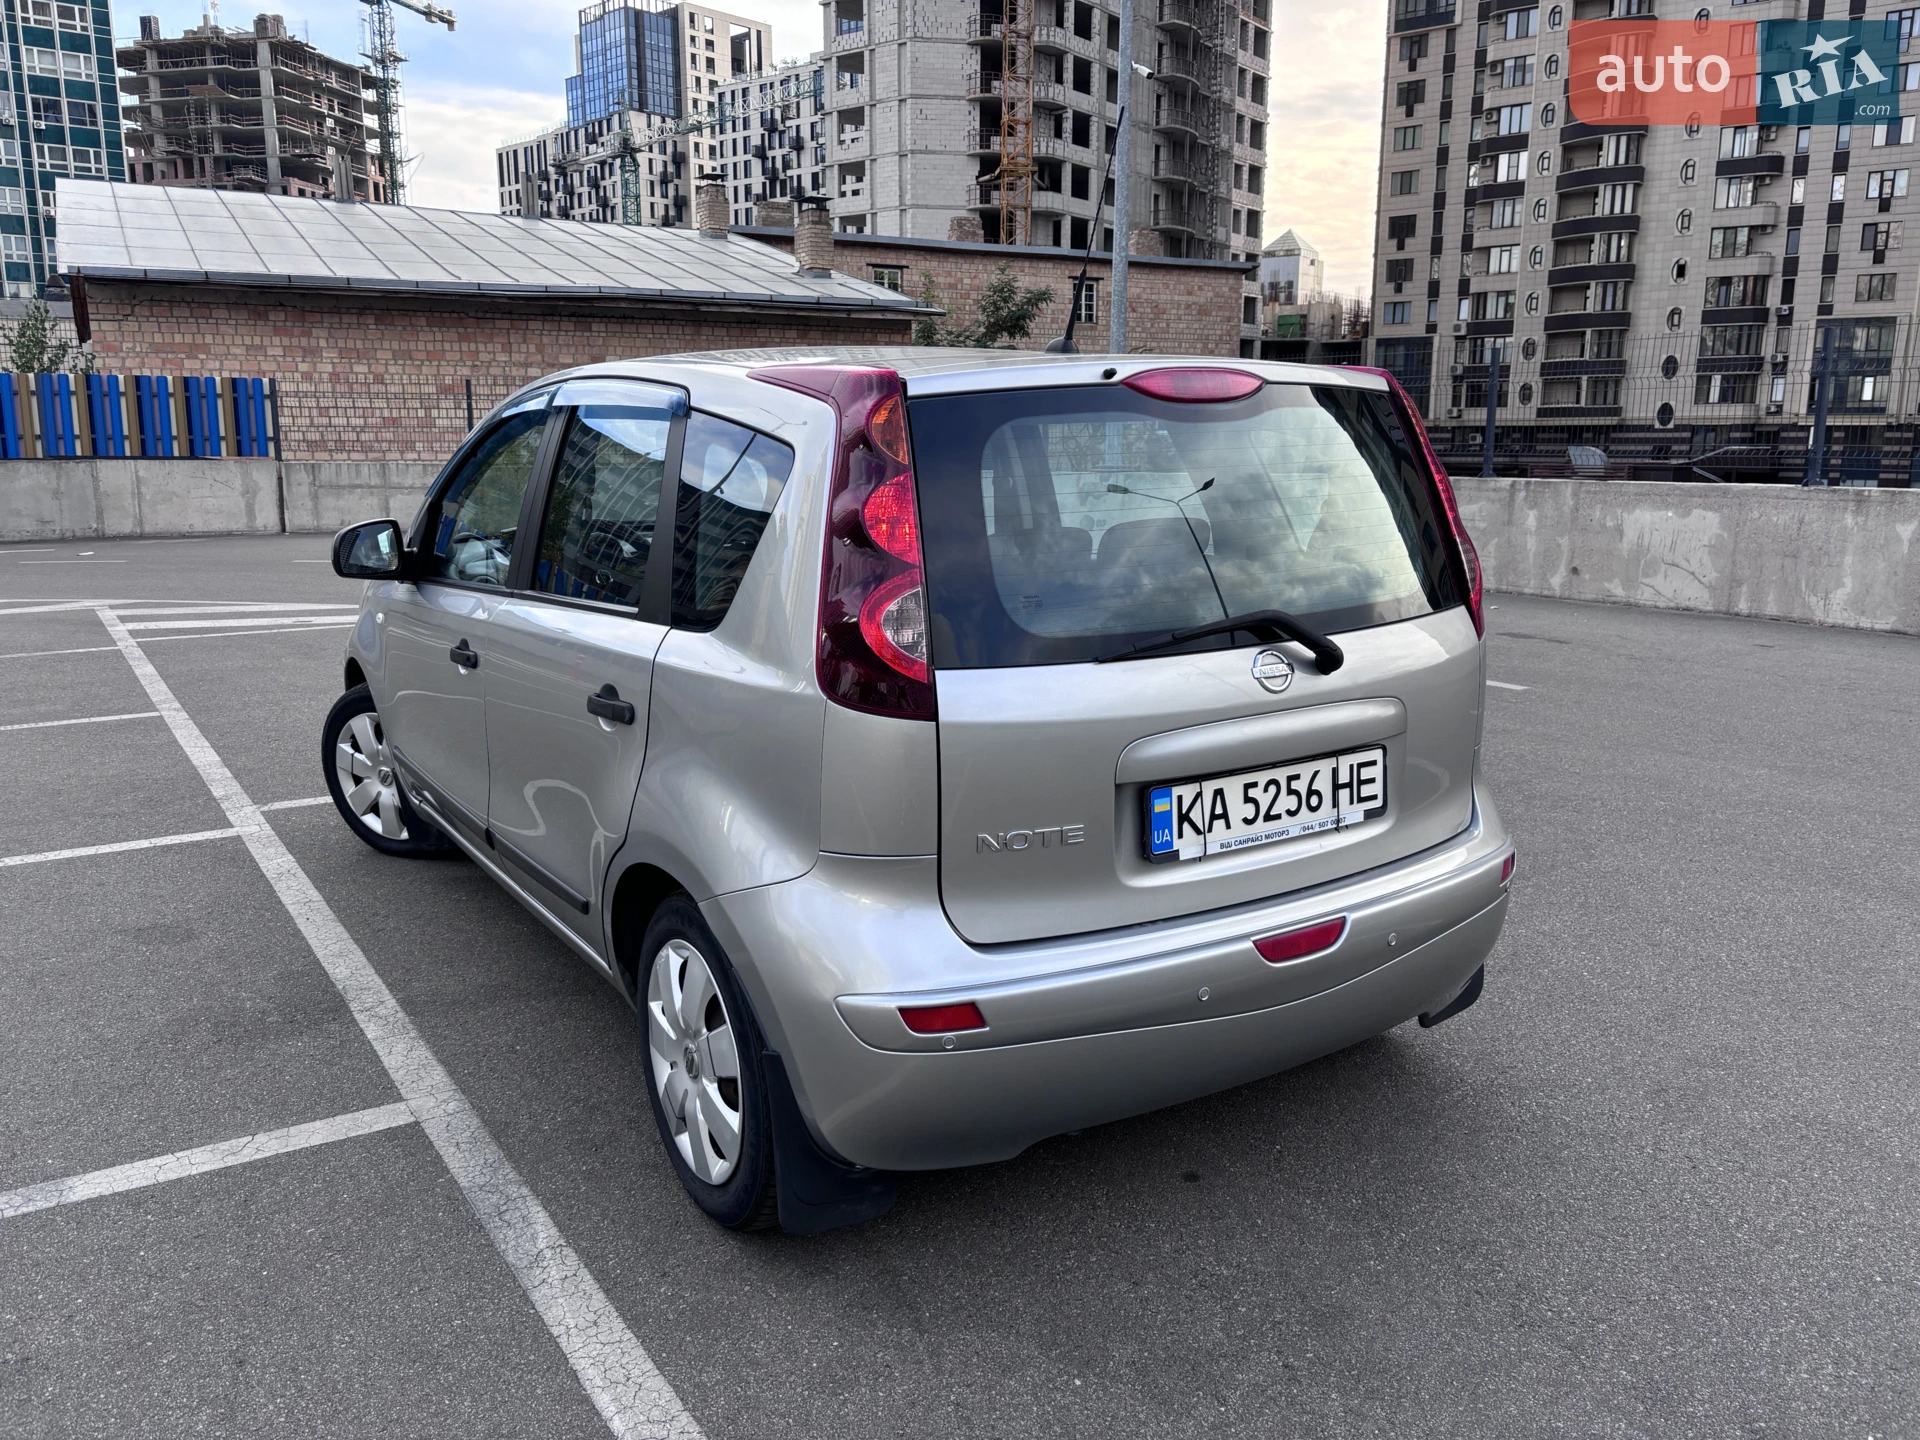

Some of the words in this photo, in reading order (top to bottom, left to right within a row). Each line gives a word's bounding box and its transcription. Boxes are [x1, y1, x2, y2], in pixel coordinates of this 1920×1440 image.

[1177, 787, 1231, 839] KA
[1242, 769, 1323, 825] 5256
[1331, 759, 1378, 809] HE
[976, 824, 1085, 853] NOTE
[1154, 829, 1171, 844] UA
[1264, 830, 1290, 840] МОТОРЗ
